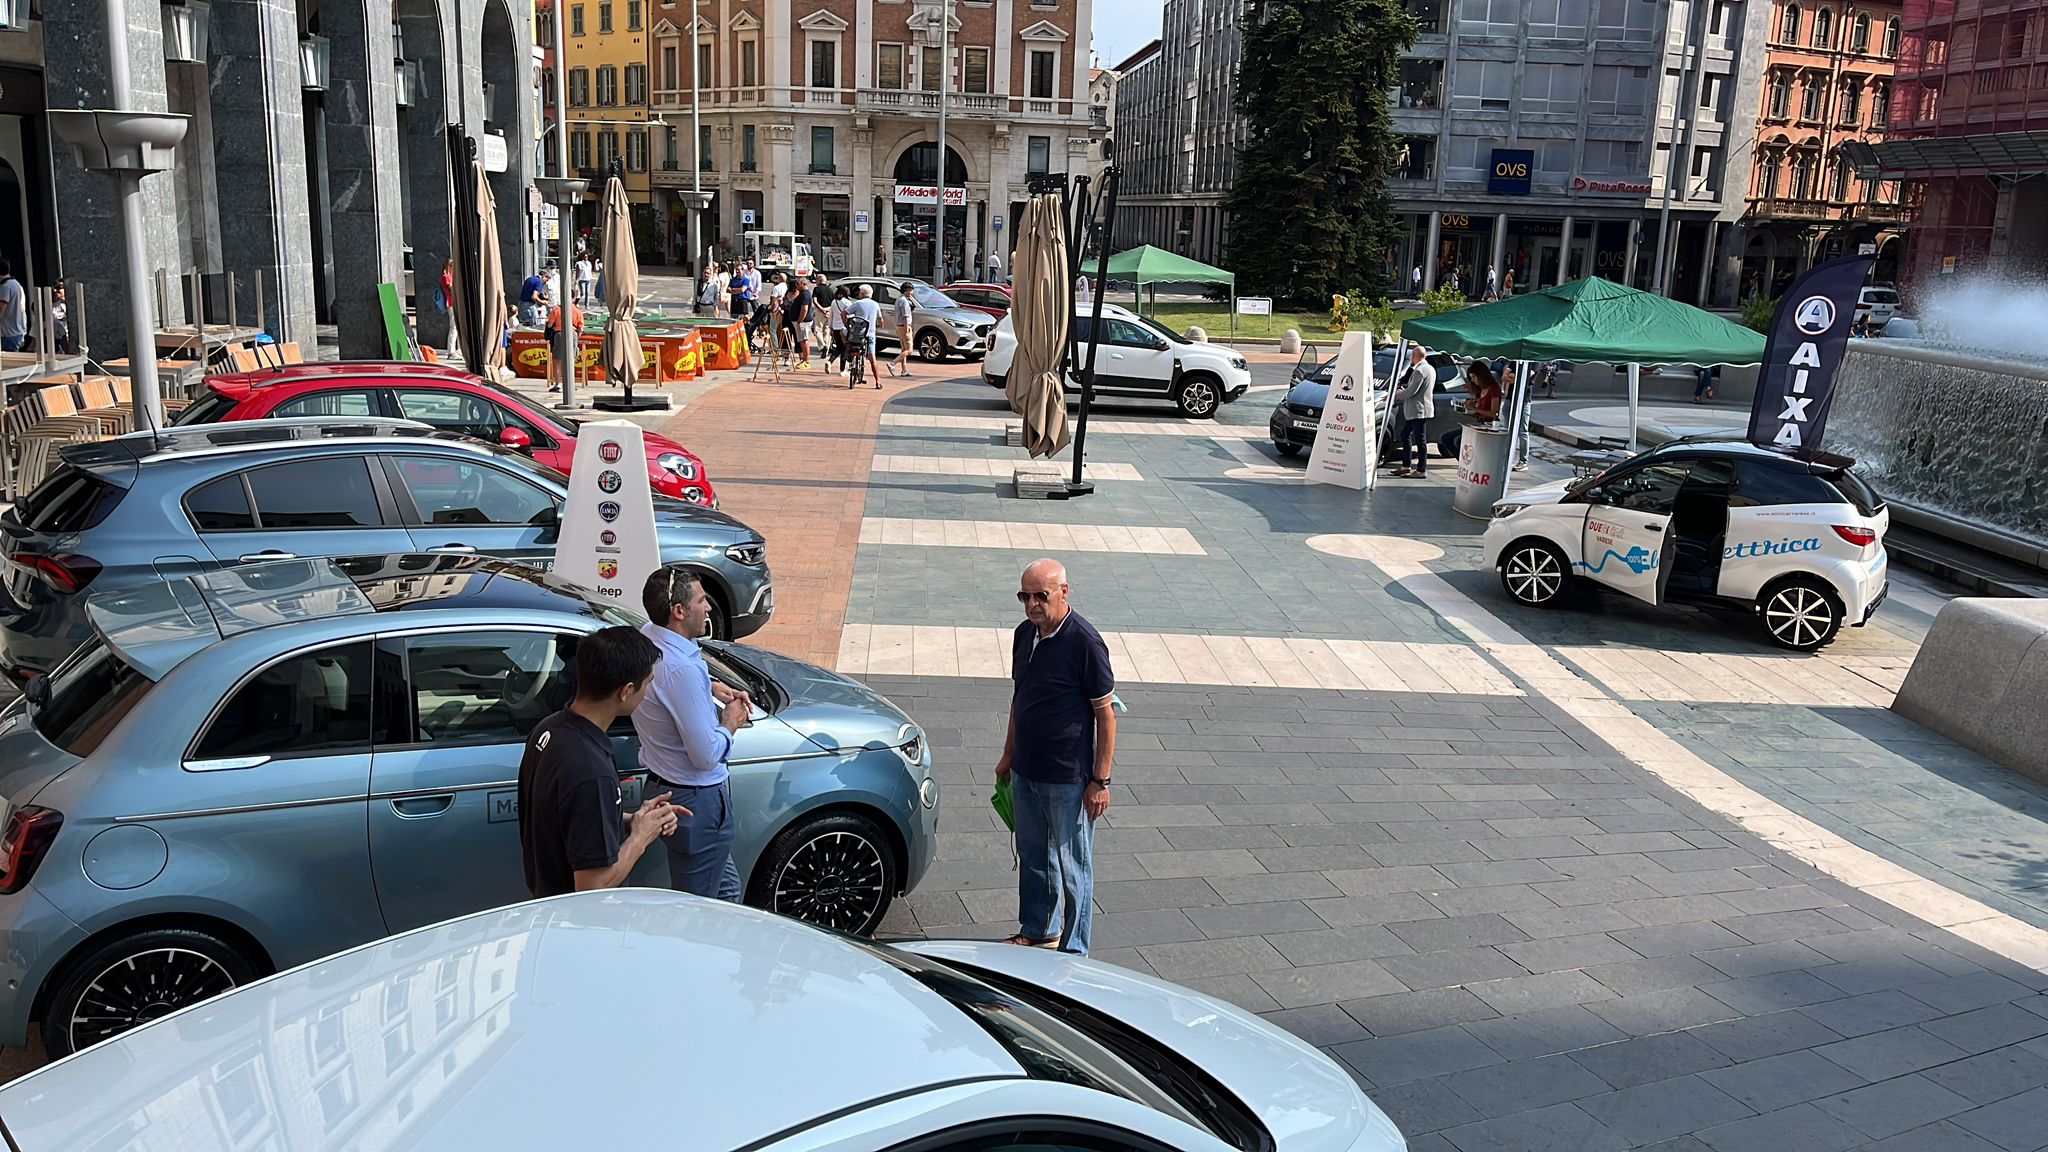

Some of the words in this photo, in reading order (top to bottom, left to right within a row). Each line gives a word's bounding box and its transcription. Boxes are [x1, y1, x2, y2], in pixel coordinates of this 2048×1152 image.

[1496, 162, 1527, 177] OVS
[899, 187, 929, 197] Media
[1441, 213, 1469, 226] OVS
[1598, 250, 1627, 268] OVS
[1335, 394, 1355, 402] AIXAM
[1343, 425, 1356, 433] CAR
[603, 446, 618, 458] FIAT
[1469, 471, 1491, 486] CAR
